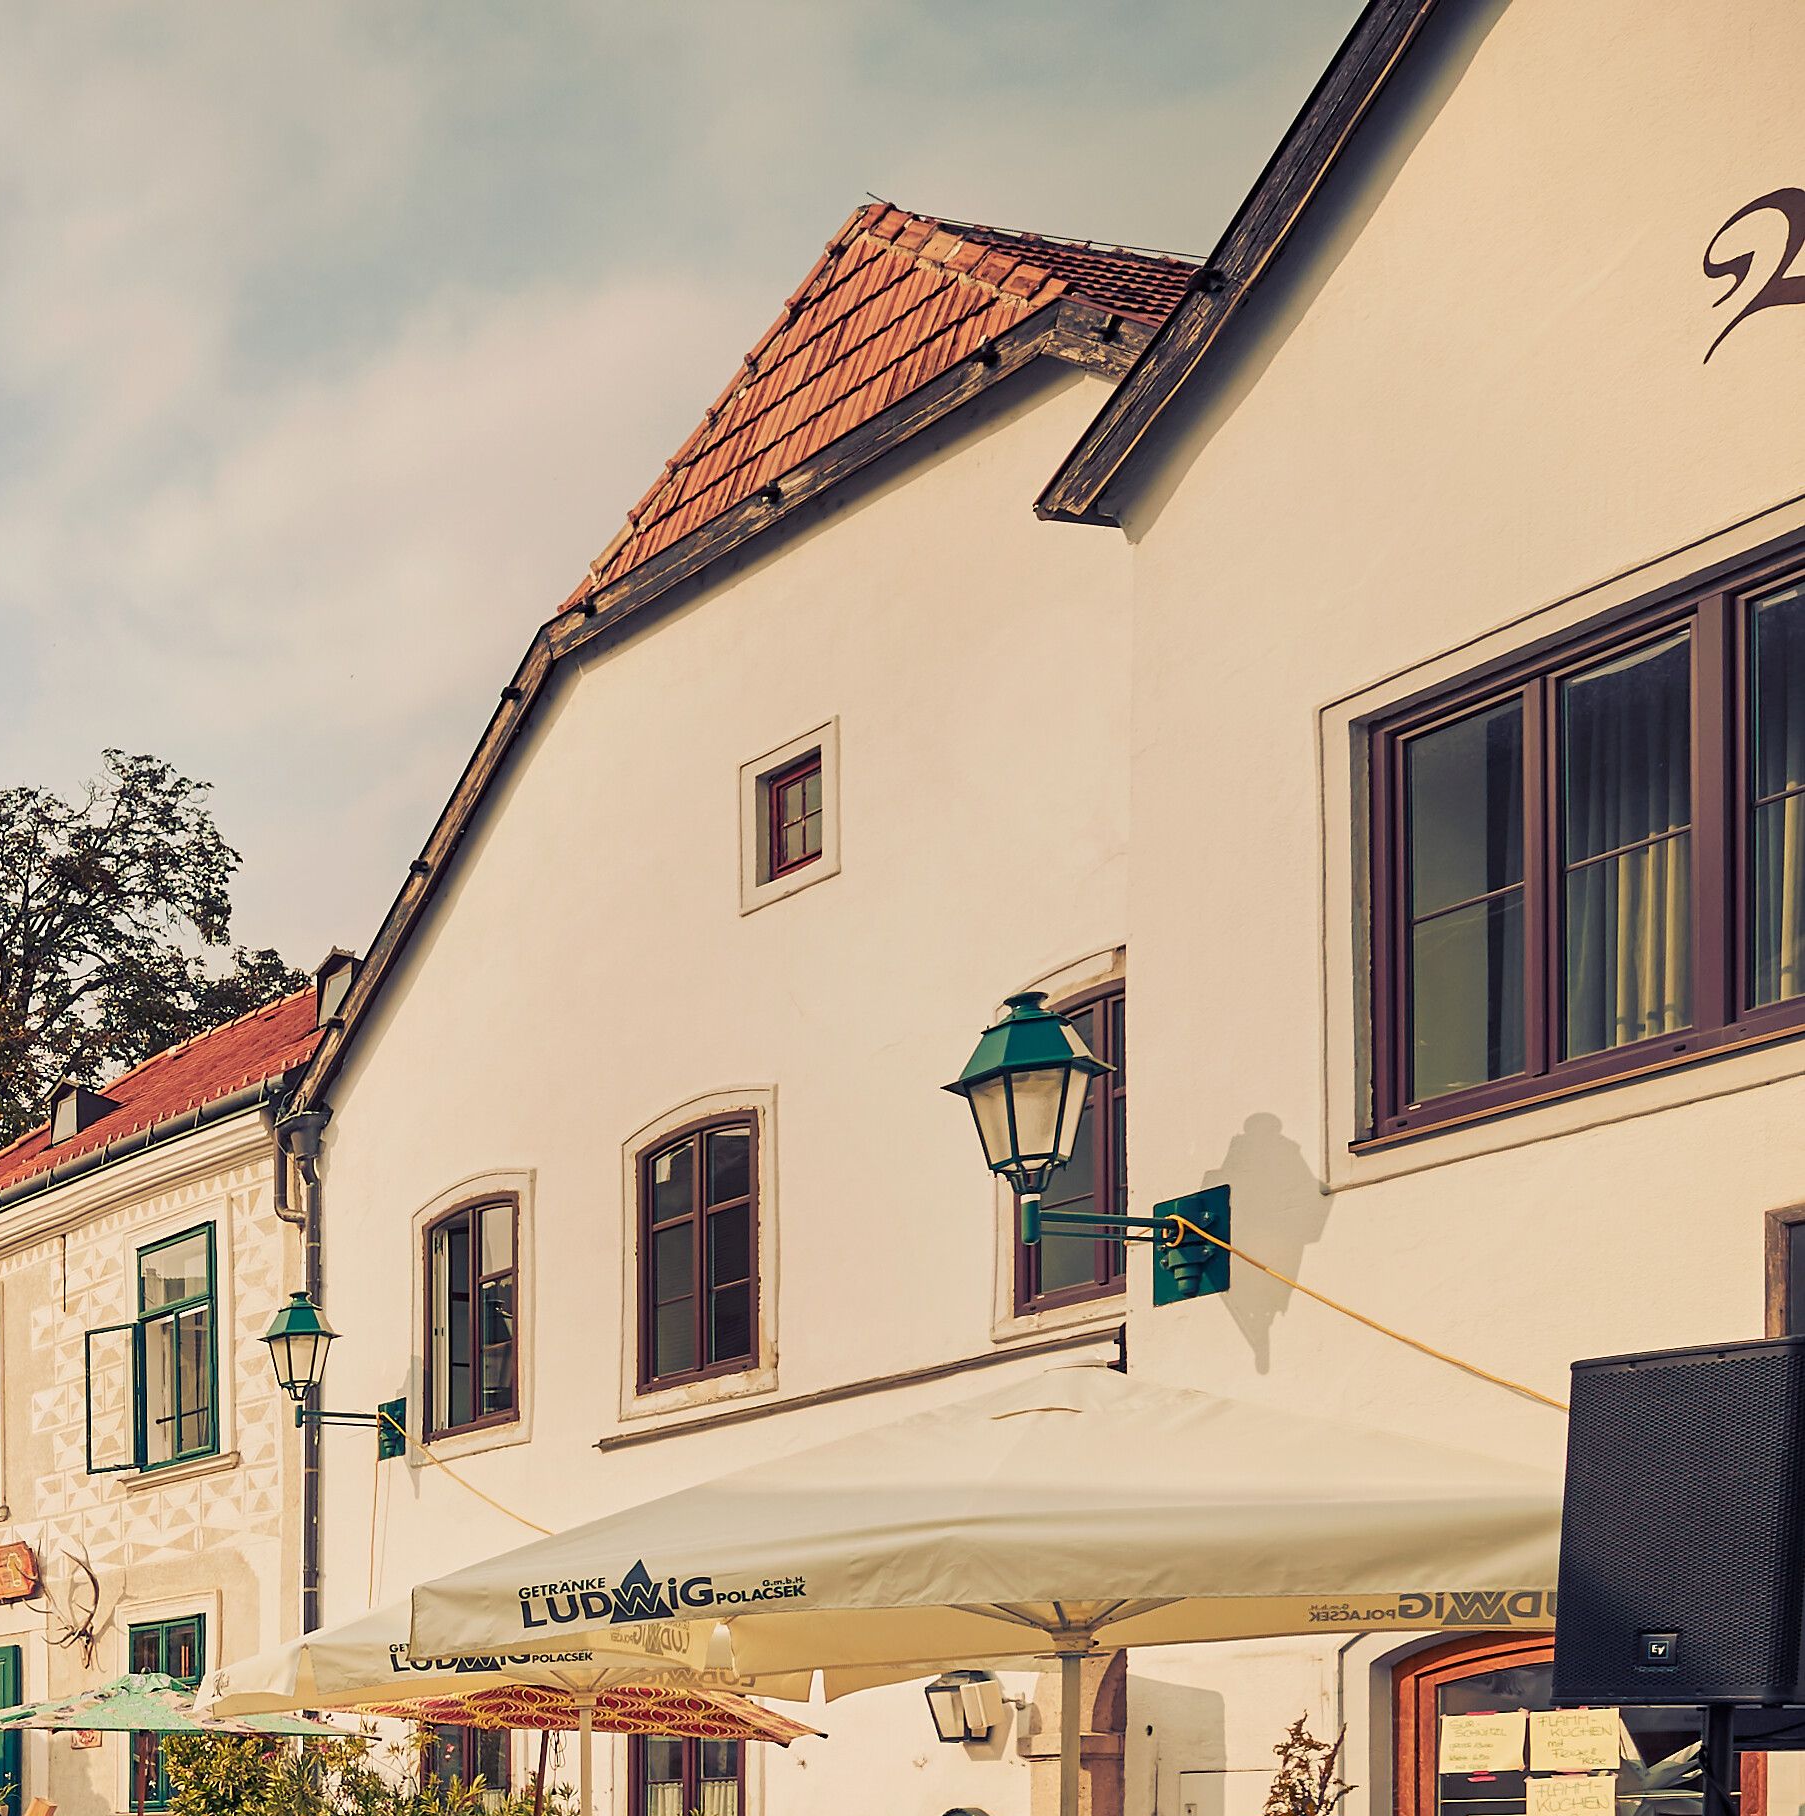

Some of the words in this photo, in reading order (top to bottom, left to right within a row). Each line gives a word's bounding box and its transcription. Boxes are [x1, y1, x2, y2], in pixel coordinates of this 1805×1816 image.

[519, 1577, 606, 1600] GETRÄNKE
[716, 1583, 807, 1605] POLACSEK
[532, 1651, 593, 1664] POLACSEK
